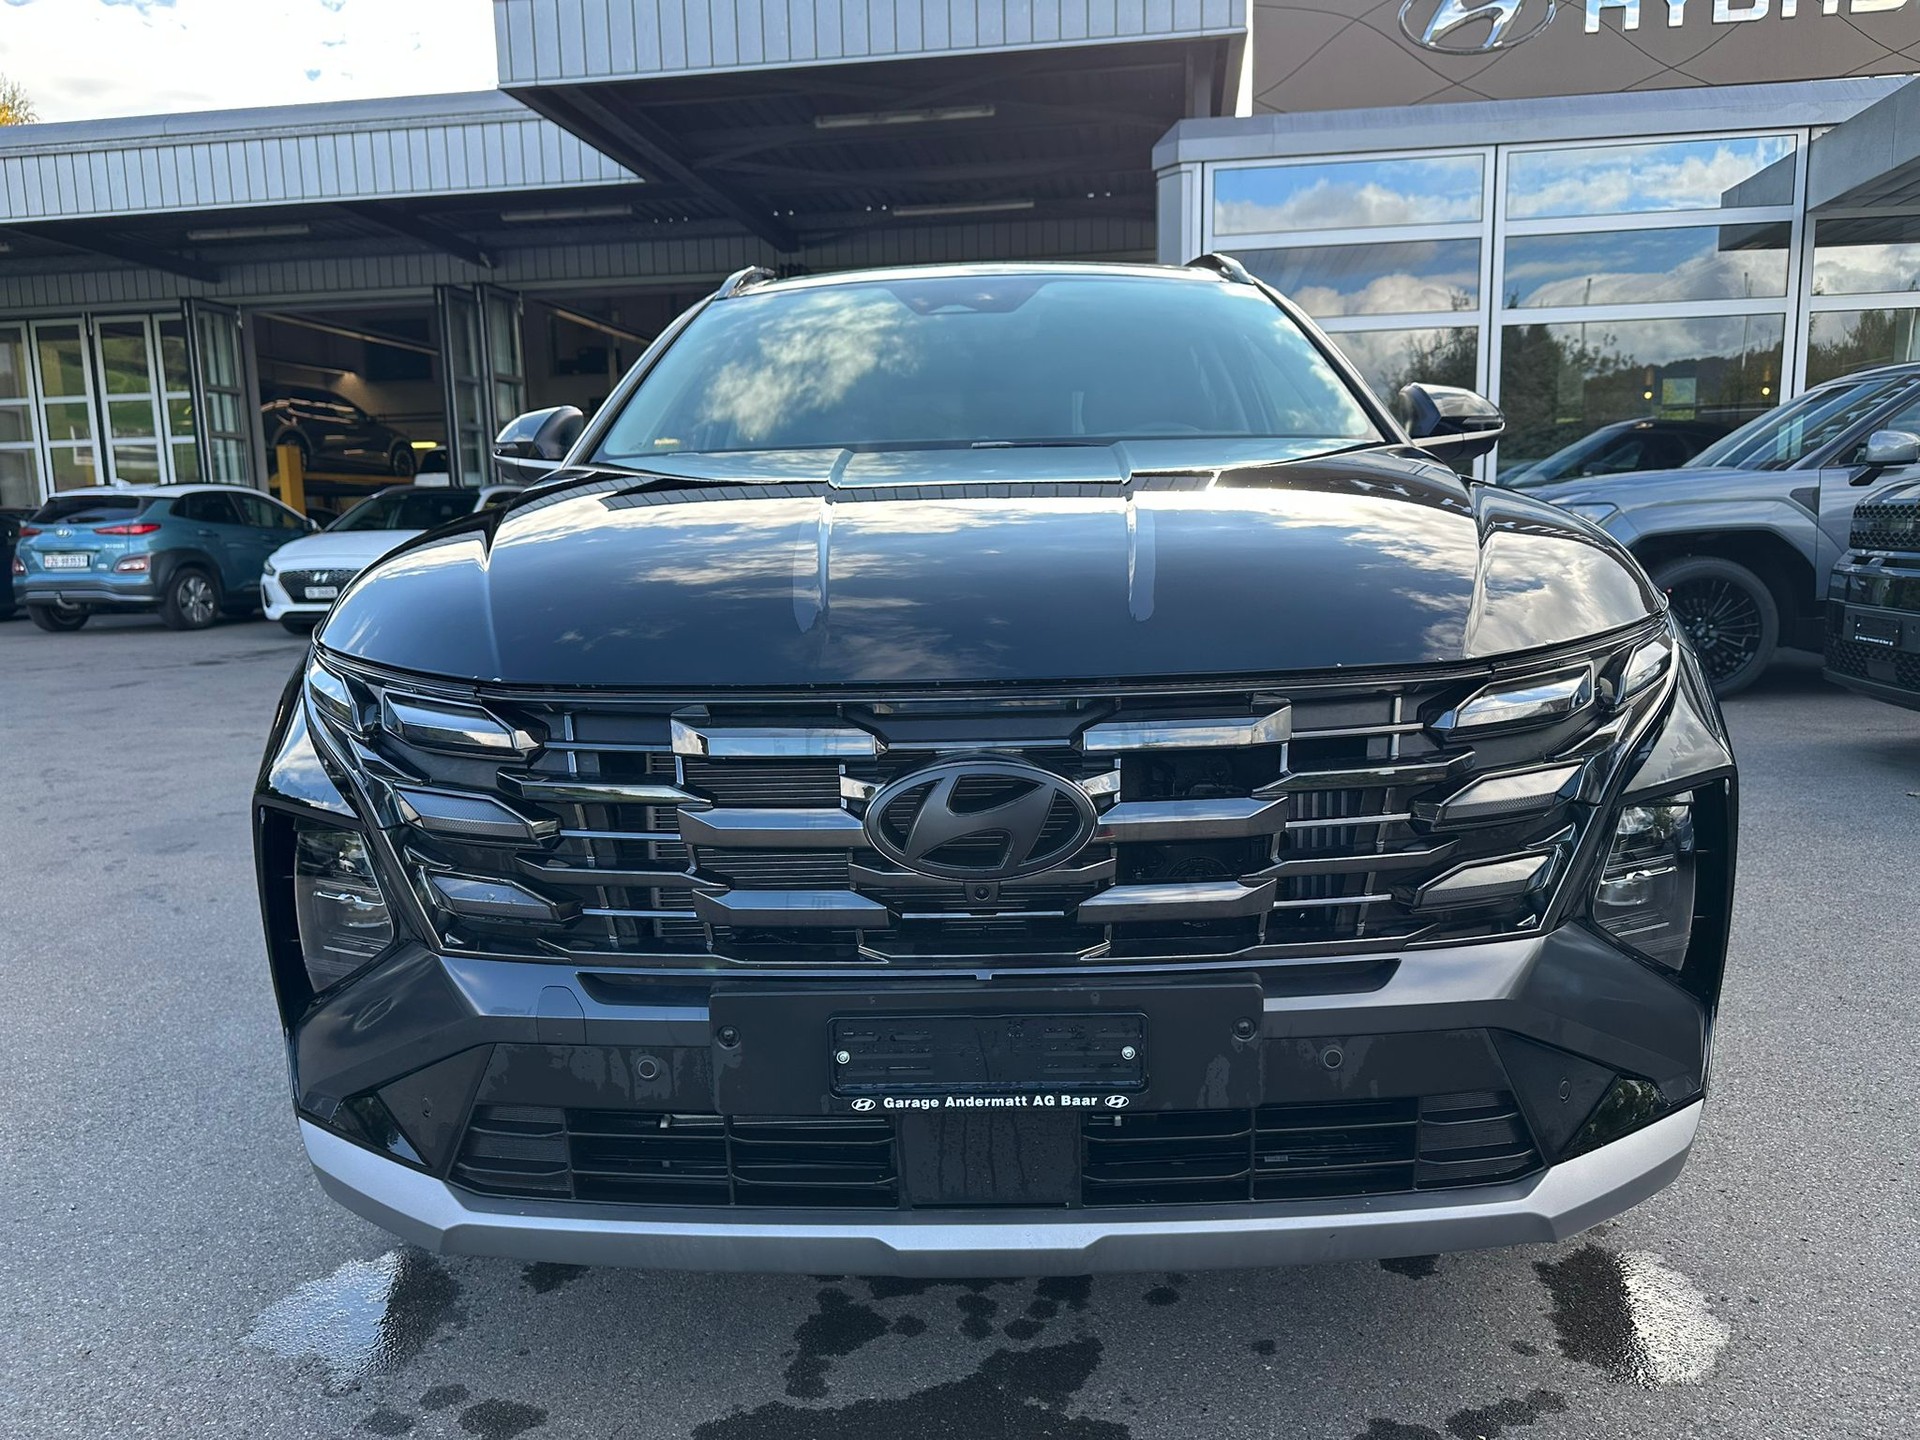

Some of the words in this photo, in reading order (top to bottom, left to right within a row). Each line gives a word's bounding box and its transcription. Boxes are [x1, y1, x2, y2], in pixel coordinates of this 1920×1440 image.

[883, 1097, 939, 1110] Garage
[944, 1095, 1028, 1107] Andermatt
[1032, 1095, 1055, 1106] AG
[1061, 1095, 1098, 1106] Baar
